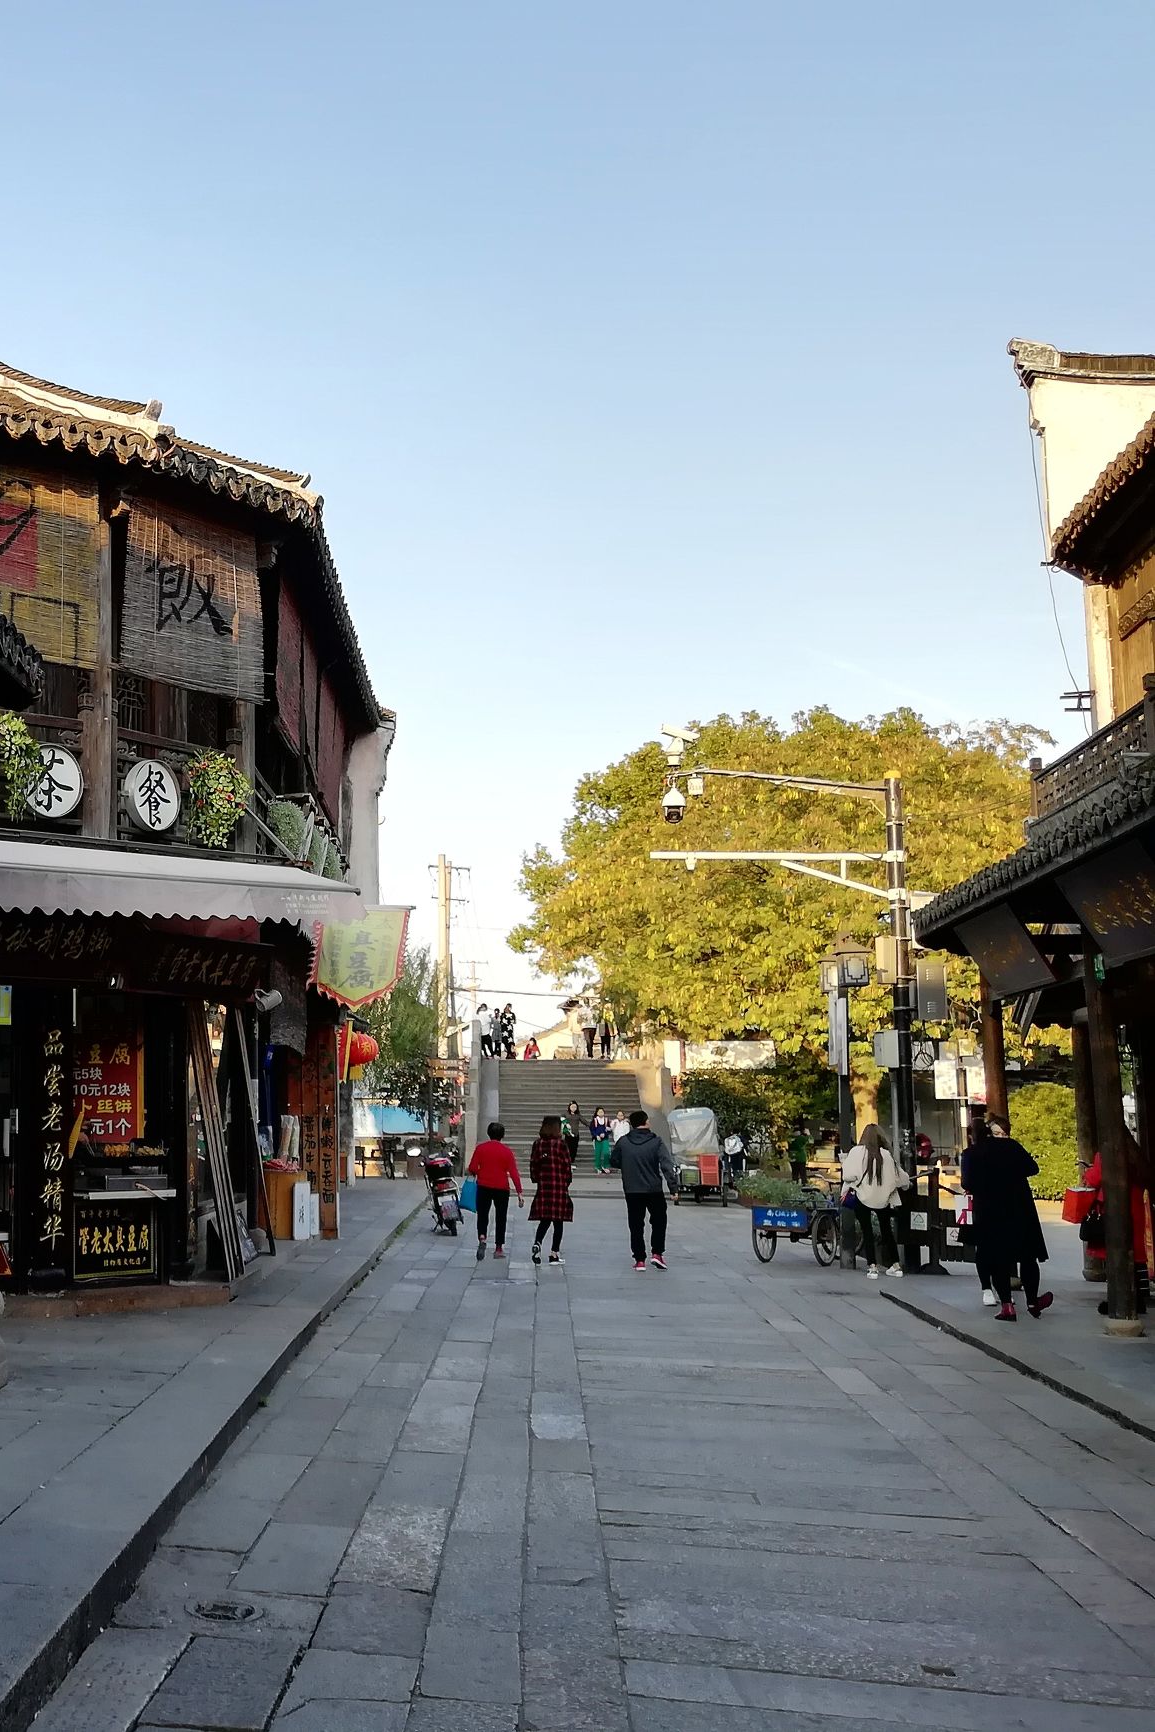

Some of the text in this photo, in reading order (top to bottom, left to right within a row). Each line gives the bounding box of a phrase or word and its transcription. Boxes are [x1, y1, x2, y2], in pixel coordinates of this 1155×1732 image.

[28, 748, 74, 812] 茶
[138, 764, 172, 828] 餐
[78, 1224, 149, 1255] 管老太臭豆腐
